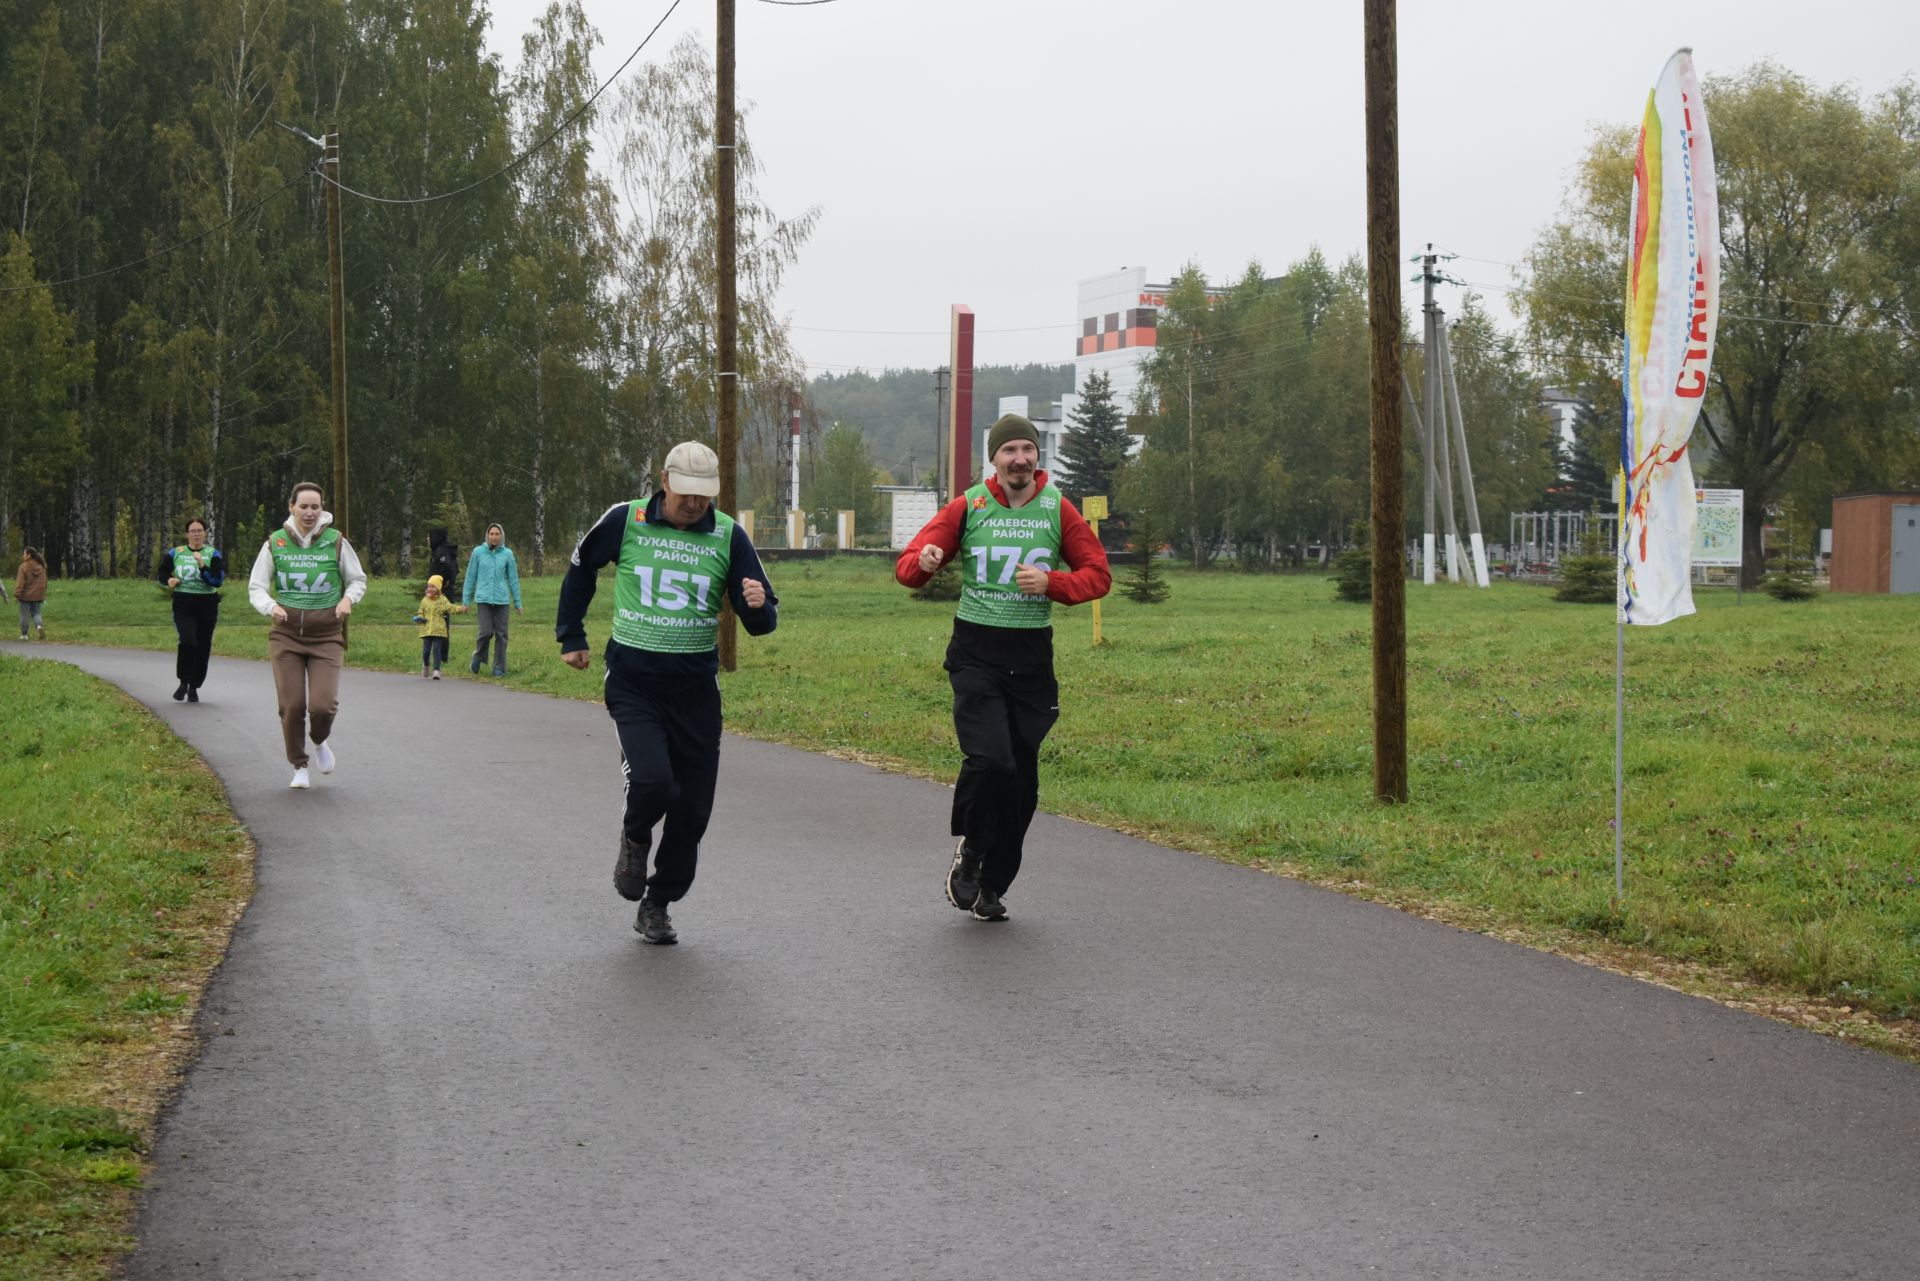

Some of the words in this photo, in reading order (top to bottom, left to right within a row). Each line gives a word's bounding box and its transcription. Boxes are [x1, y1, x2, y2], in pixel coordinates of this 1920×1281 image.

[1680, 129, 1695, 257] СПОРТОМ
[992, 528, 1034, 539] РАЙОН
[279, 553, 329, 561] ТУКАЕВСКИЙ
[636, 536, 718, 558] ТУКАЕВСКИЙ
[653, 550, 699, 565] РАЙОН
[277, 570, 332, 592] 134
[634, 565, 711, 612] 151
